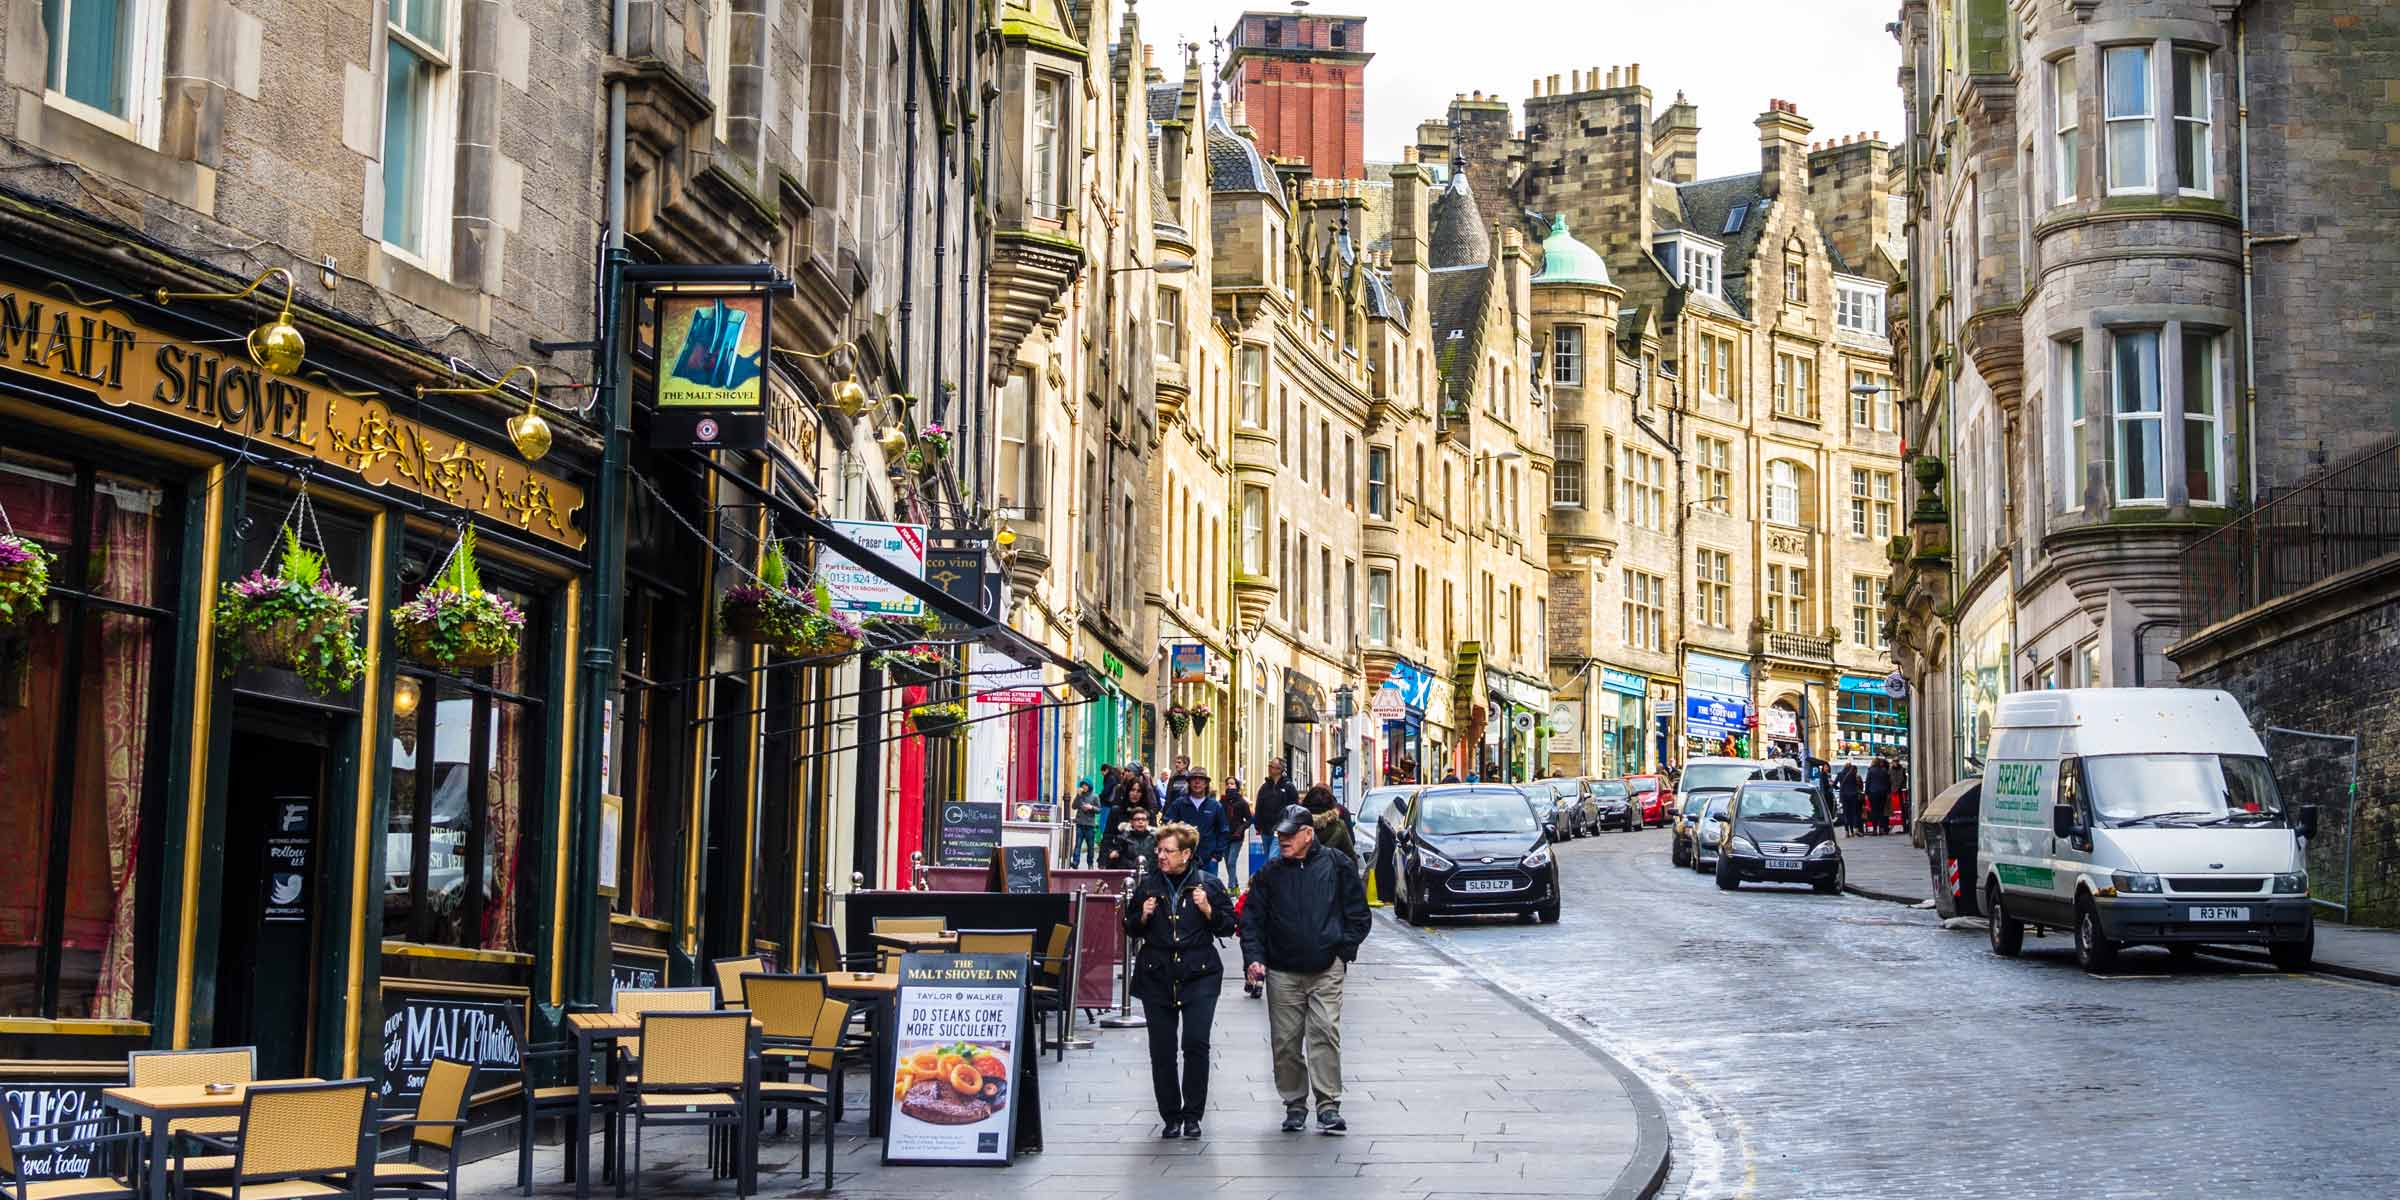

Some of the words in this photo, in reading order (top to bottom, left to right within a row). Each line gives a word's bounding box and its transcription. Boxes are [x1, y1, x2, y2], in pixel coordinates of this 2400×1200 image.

[0, 292, 136, 390] MALT
[154, 343, 319, 450] SHOVEL
[664, 391, 684, 400] THE
[686, 391, 713, 400] MALT
[715, 391, 756, 400] SHOVEL
[767, 388, 799, 453] HOVEL
[858, 536, 881, 549] Fraser
[884, 538, 903, 551] Legal
[926, 559, 945, 568] cco
[949, 558, 977, 568] vino
[853, 573, 870, 583] 524
[1997, 764, 2042, 796] BREMAC
[271, 846, 306, 857] Follow
[290, 857, 304, 866] us
[1470, 881, 1491, 890] SL63
[1494, 881, 1510, 889] LZP
[2200, 908, 2215, 919] R3
[2217, 908, 2238, 919] FYN
[954, 960, 974, 968] THE
[908, 970, 943, 980] MALT
[945, 970, 993, 980] SHOVEL
[997, 970, 1017, 980] INN
[912, 1008, 926, 1022] DO
[931, 1008, 970, 1023] STEAKS
[975, 1009, 1003, 1023] COME
[403, 1006, 484, 1062] MALT
[906, 1024, 935, 1036] MORE
[939, 1024, 1007, 1037] SUCCULENT?
[51, 1089, 104, 1153] Chip
[22, 1154, 52, 1176] ered
[55, 1153, 91, 1178] today
